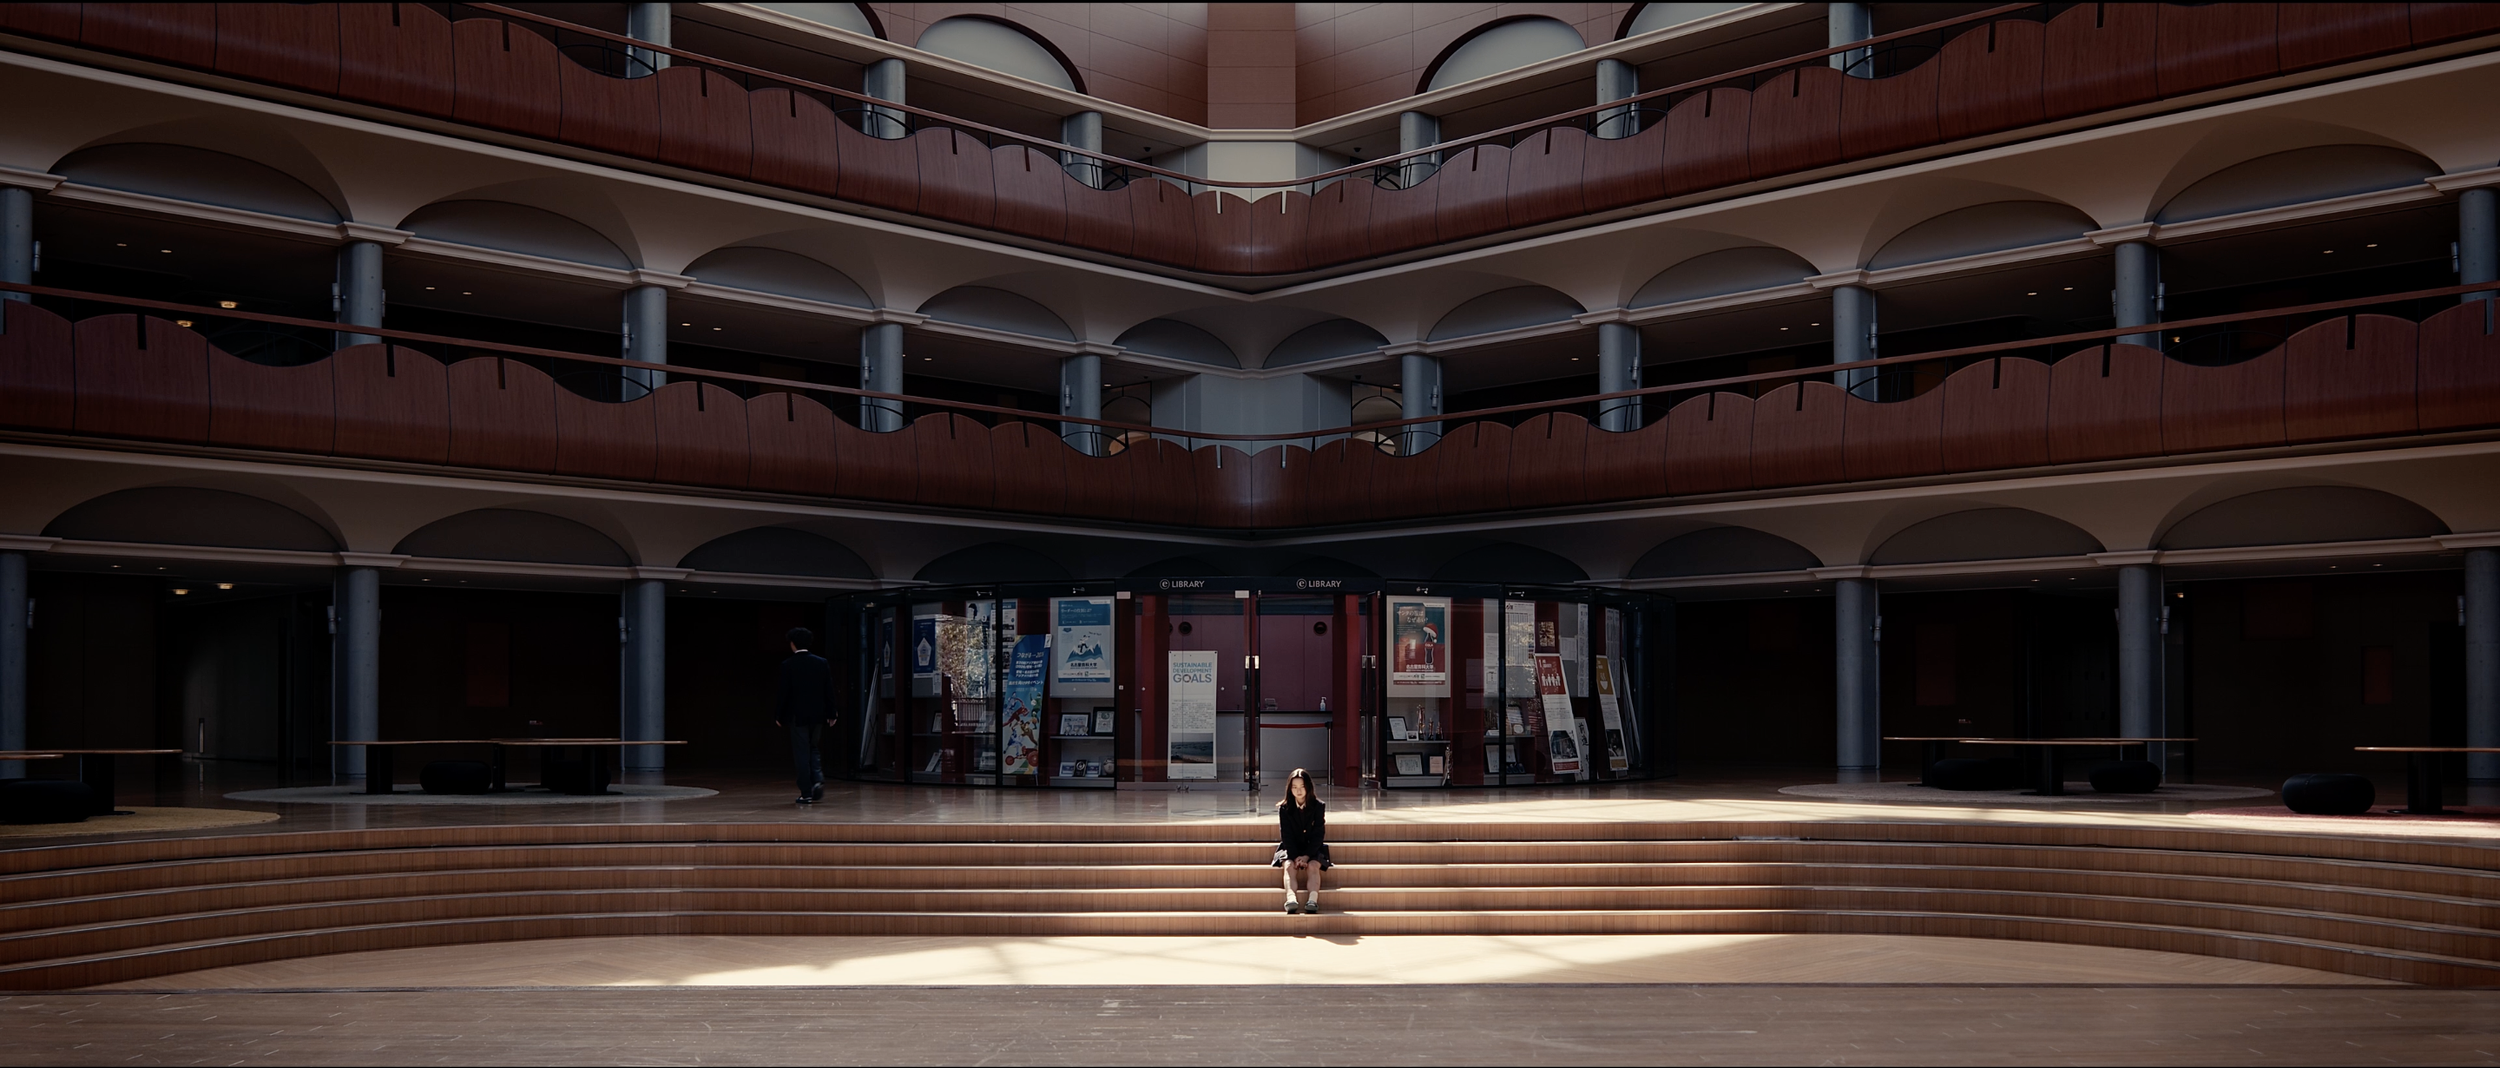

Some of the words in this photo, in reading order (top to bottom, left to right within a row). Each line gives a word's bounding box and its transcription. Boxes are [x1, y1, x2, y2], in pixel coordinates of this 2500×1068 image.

[1172, 580, 1205, 588] LIBRARY
[1308, 580, 1342, 588] LIBRARY
[1173, 673, 1212, 683] GOALS
